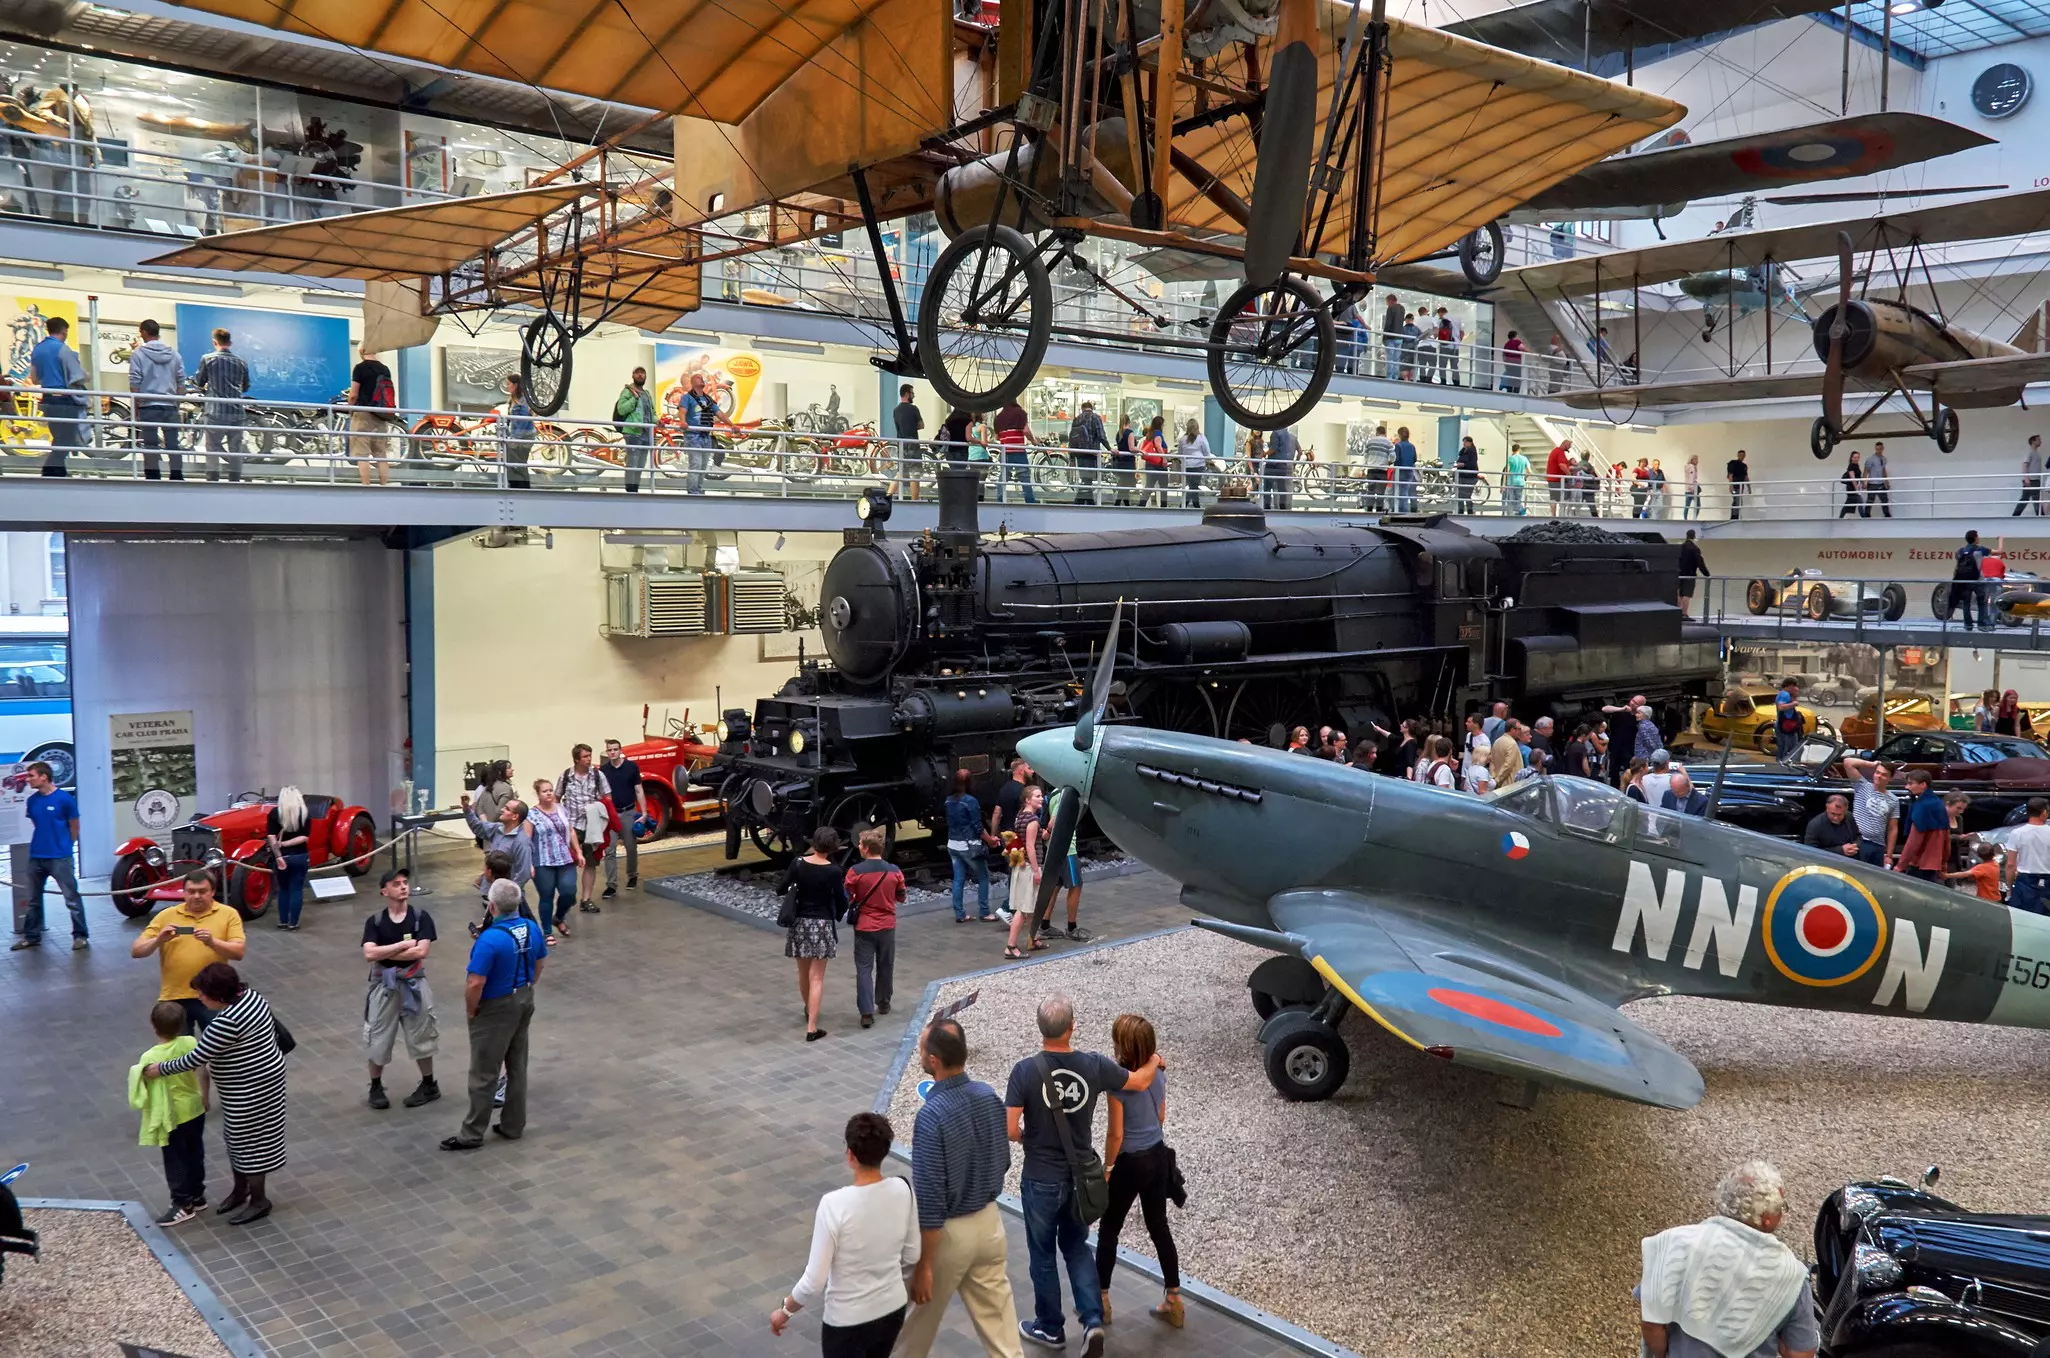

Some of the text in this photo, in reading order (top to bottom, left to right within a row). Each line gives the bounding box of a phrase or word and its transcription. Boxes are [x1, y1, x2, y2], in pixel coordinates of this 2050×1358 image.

[1817, 548, 2050, 560] AUTOMOBILY ŽELEZN ASIČSK
[129, 720, 176, 729] VETERAN
[1872, 918, 1950, 1013] N
